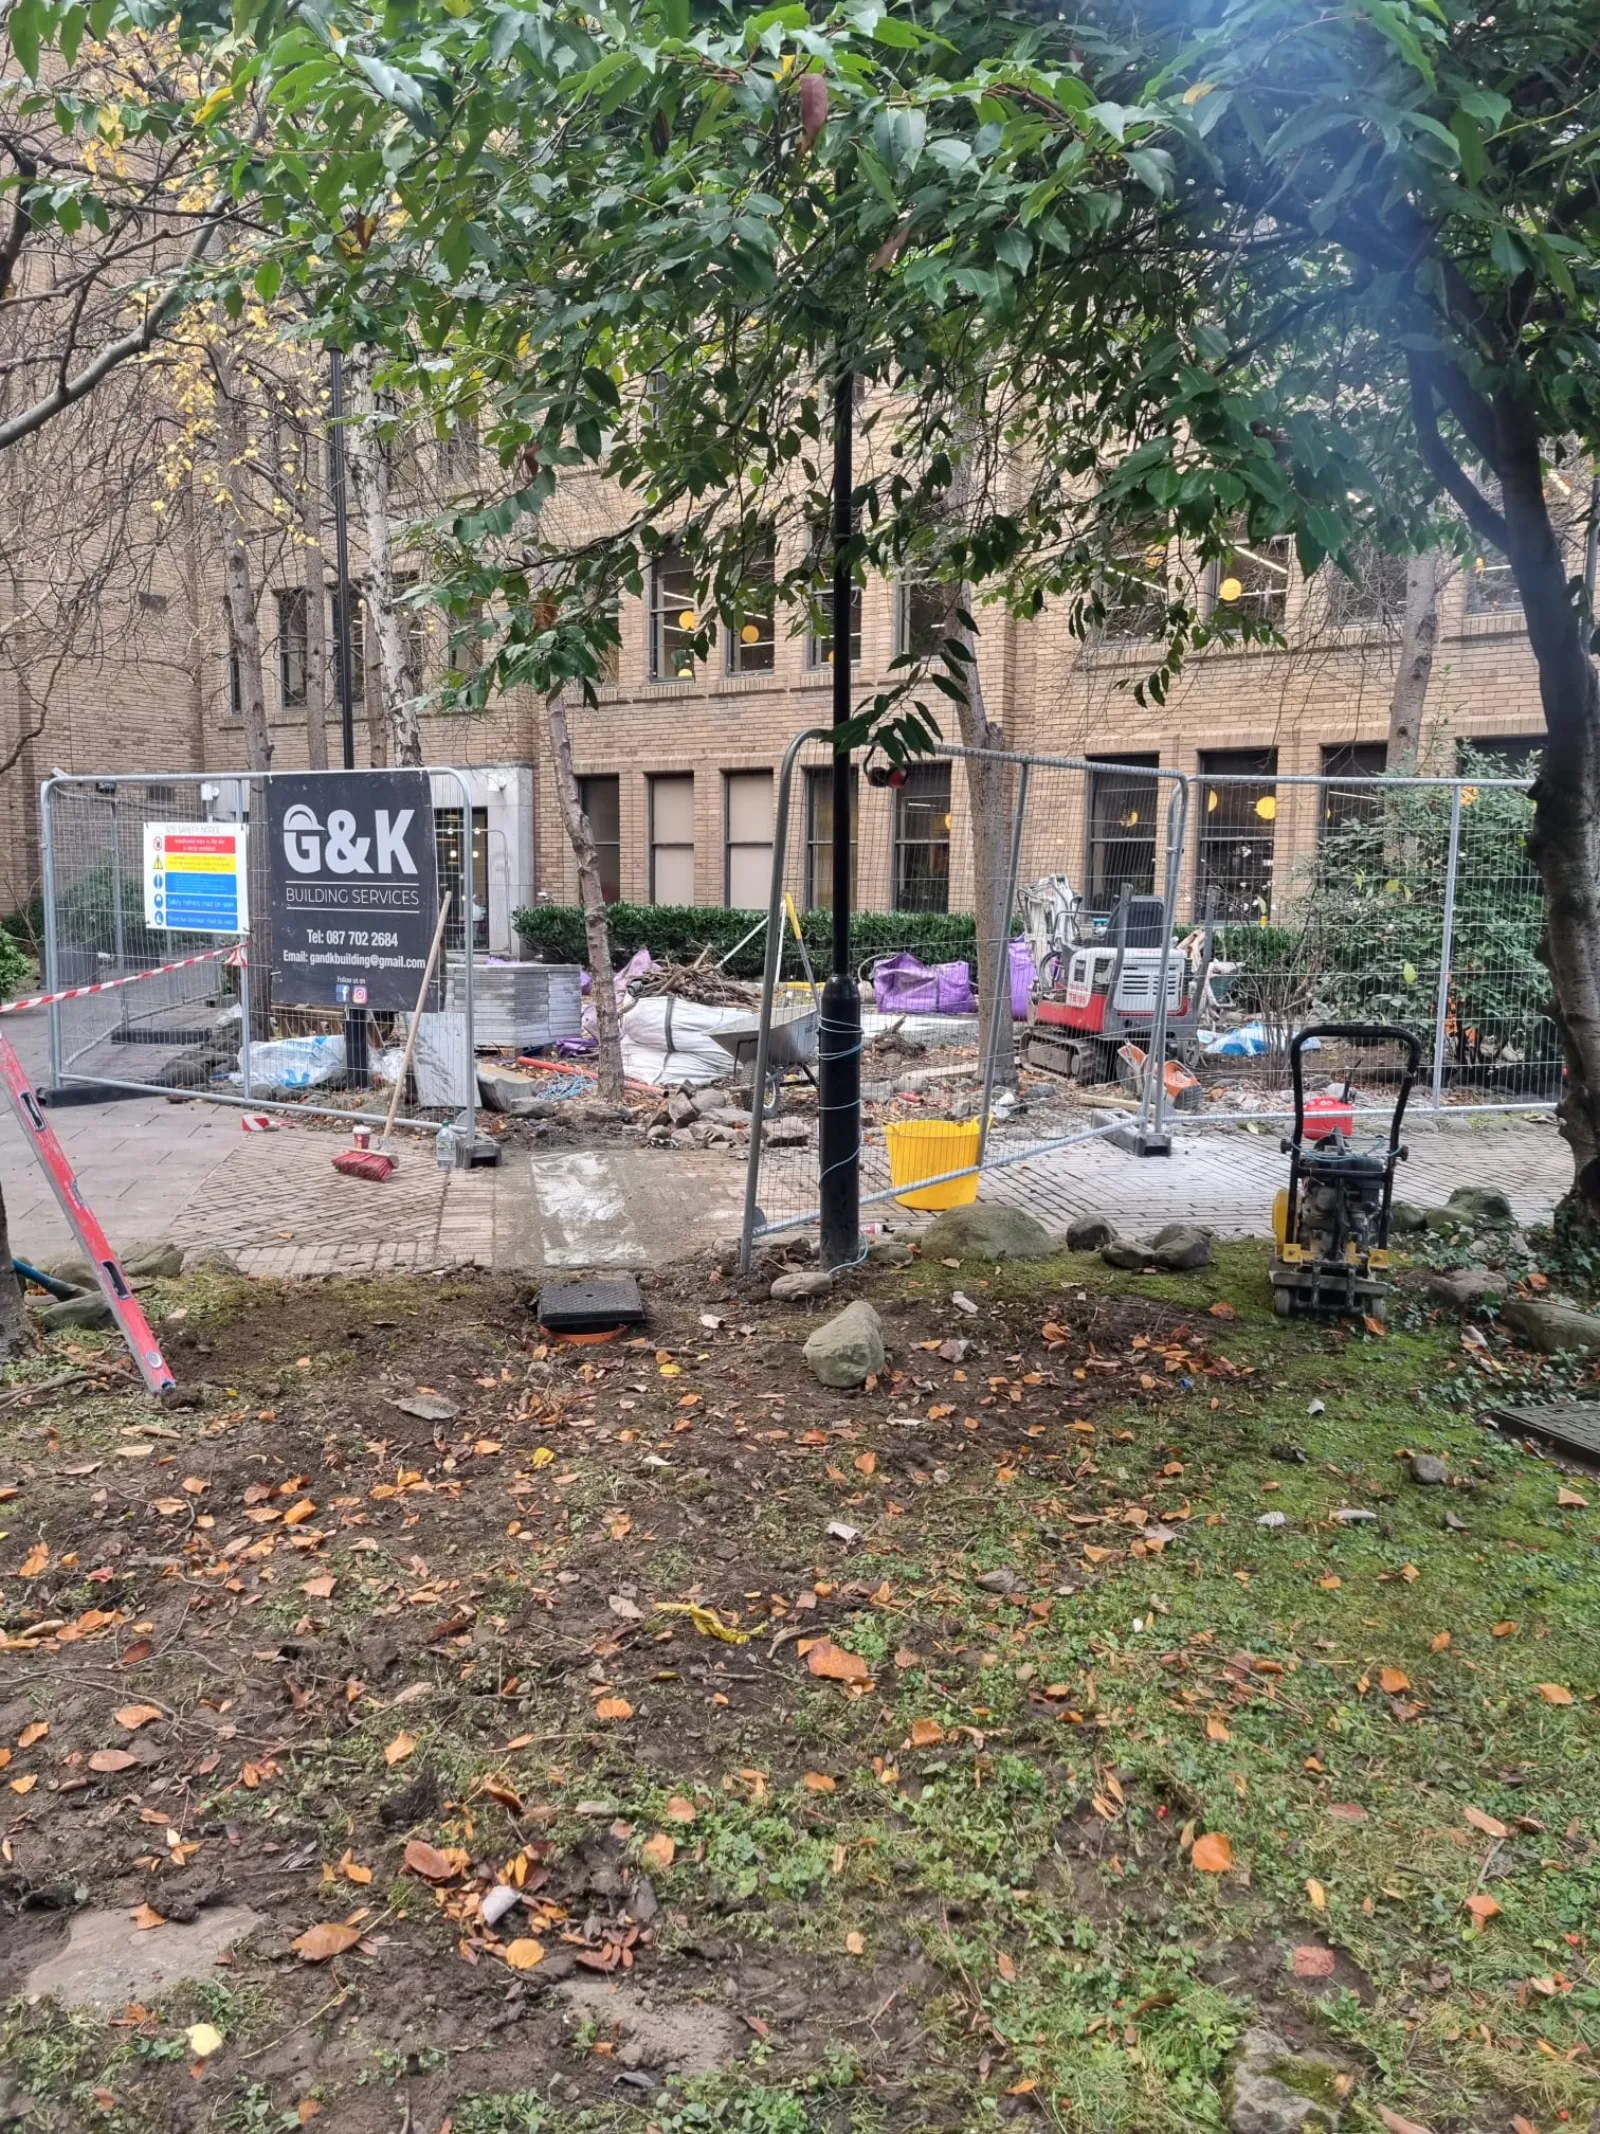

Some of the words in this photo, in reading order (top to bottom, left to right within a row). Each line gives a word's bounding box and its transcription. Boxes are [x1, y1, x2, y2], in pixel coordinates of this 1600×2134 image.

[283, 804, 418, 874] G&K
[286, 888, 348, 903] BUILDING
[351, 890, 420, 905] SERVICES
[307, 929, 324, 944] Tel:
[326, 930, 345, 945] 087
[348, 932, 369, 946] 702
[371, 932, 398, 947] 2684
[283, 950, 308, 963] Email:
[310, 952, 426, 969] gandkbuilding@gmail.com
